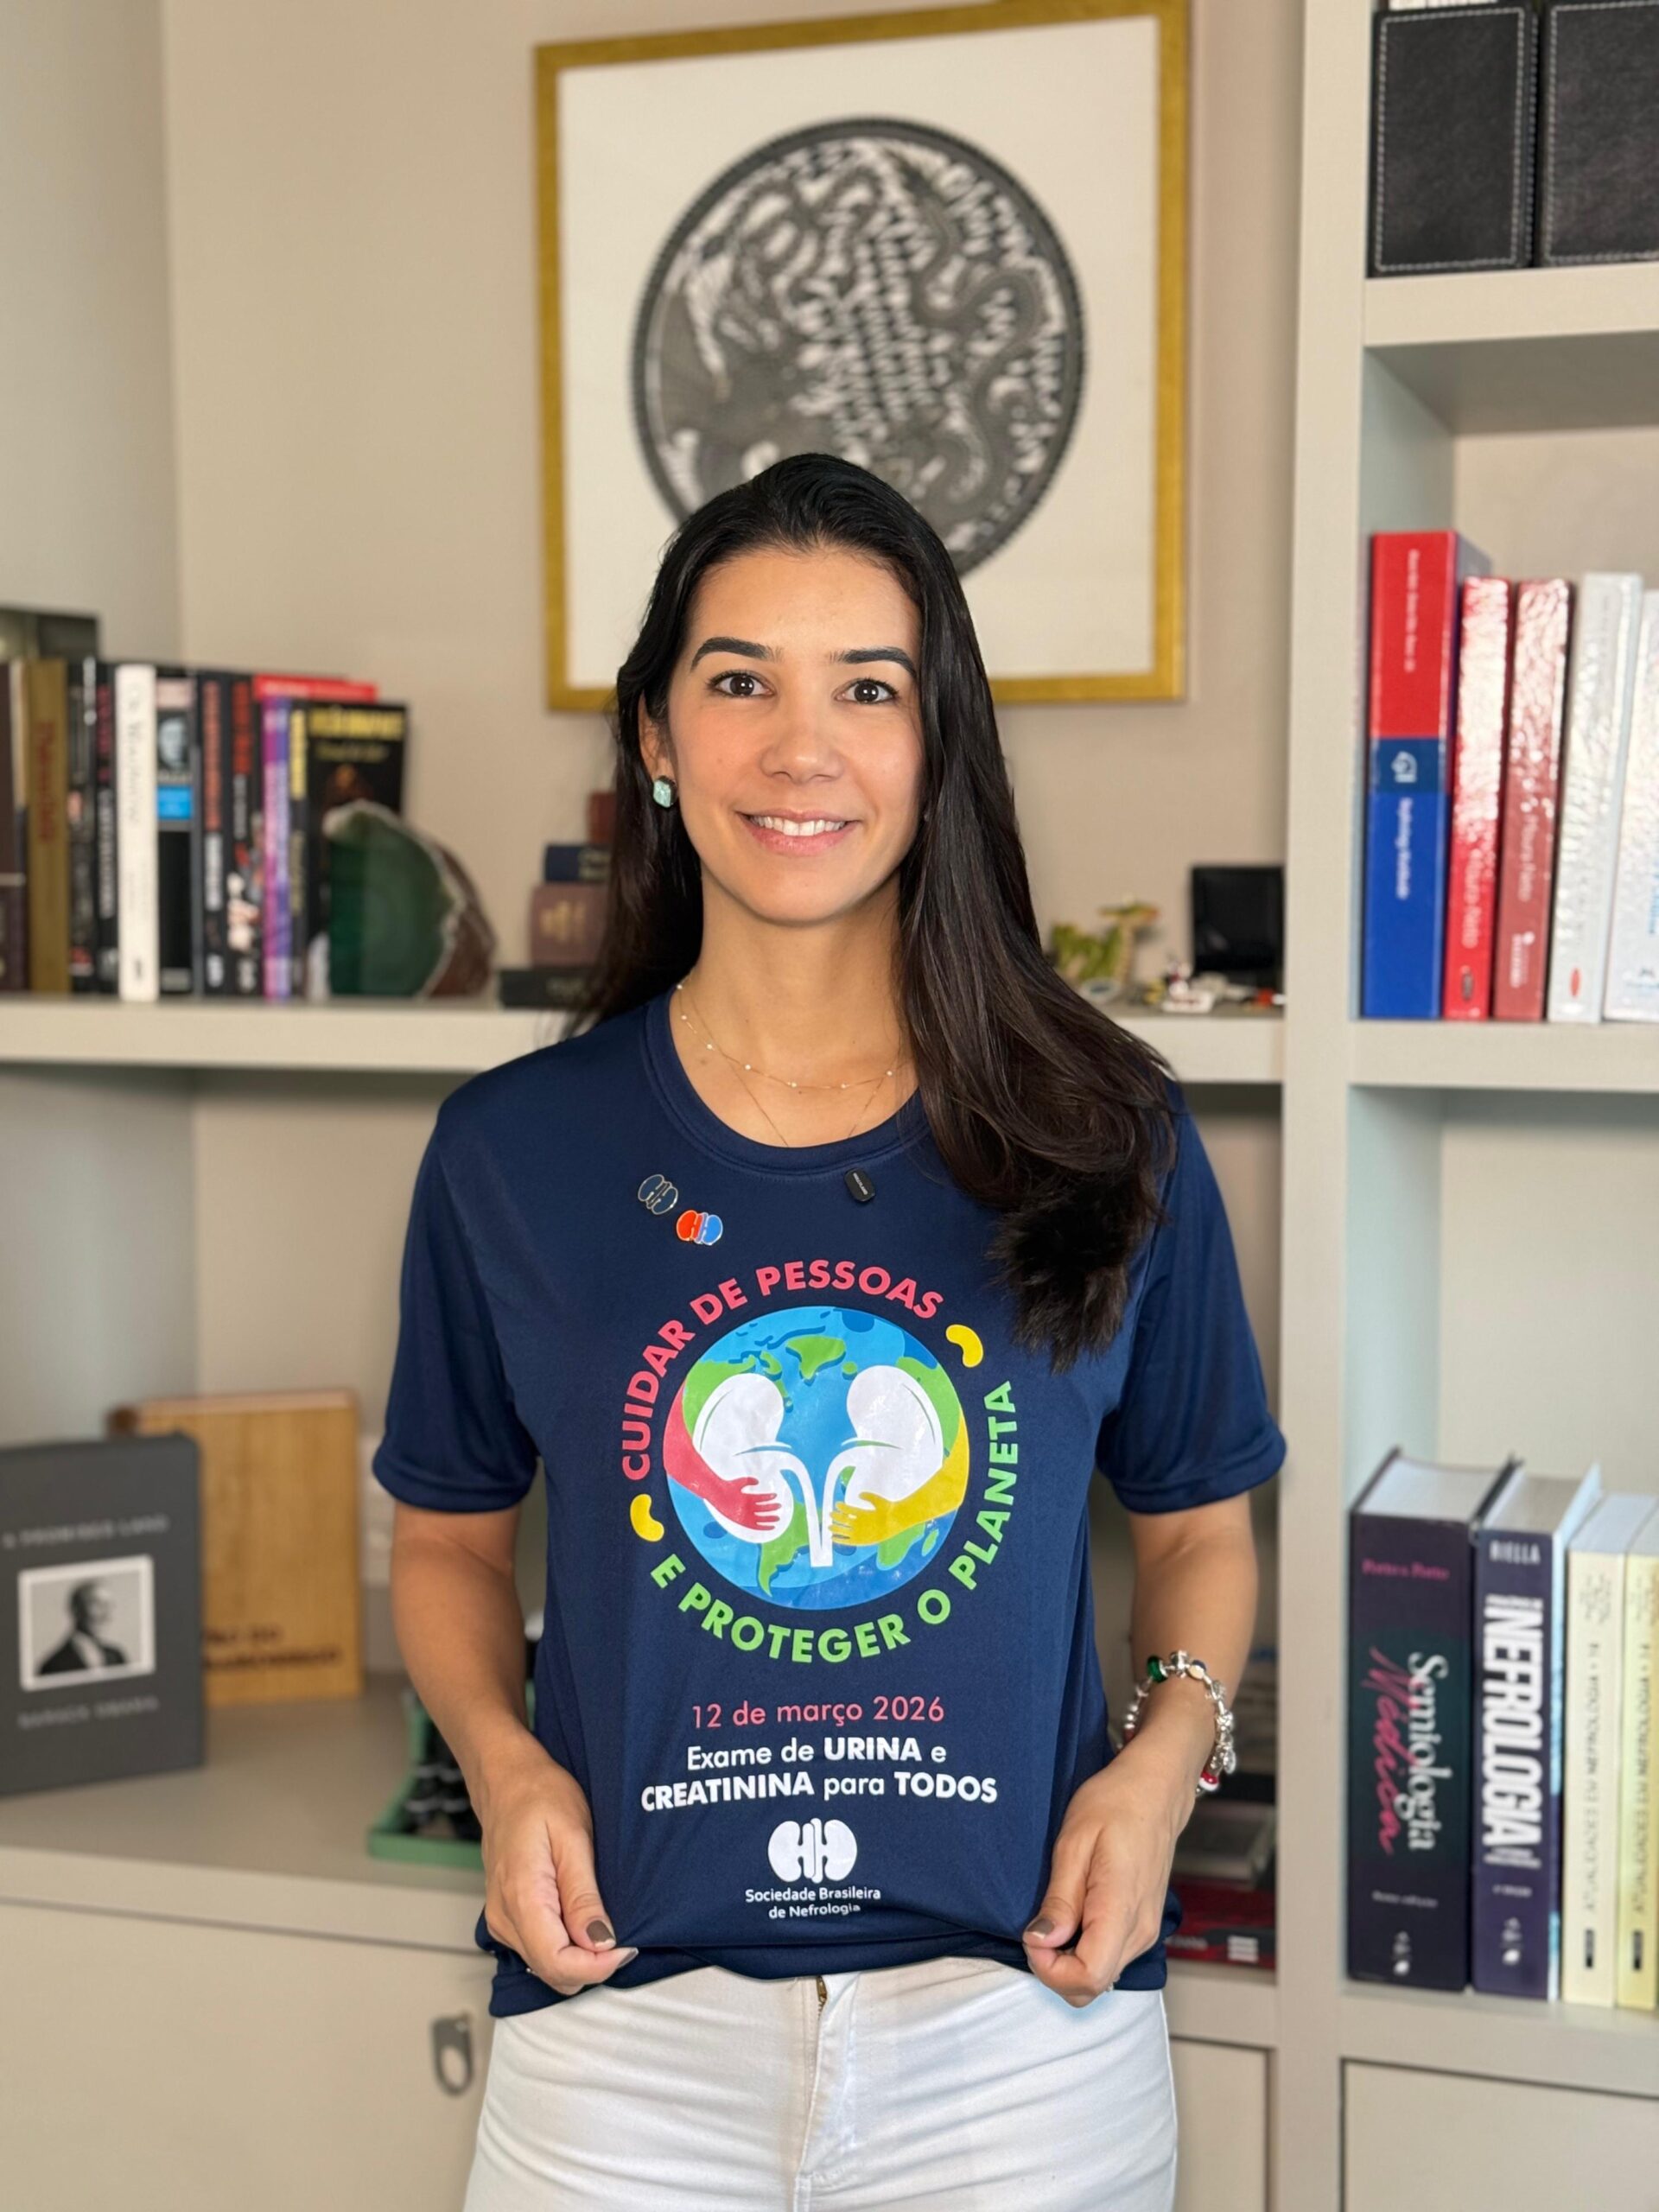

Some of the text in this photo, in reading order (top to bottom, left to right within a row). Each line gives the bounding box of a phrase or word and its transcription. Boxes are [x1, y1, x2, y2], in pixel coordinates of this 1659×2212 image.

[622, 1259, 944, 1480] CUIDAR DE PESSOAS
[651, 1381, 1018, 1663] E PROTEGER O PLANETA
[694, 1695, 944, 1728] 12 de março 2026
[1483, 1605, 1544, 1847] NEFROLOGIA
[687, 1737, 947, 1770] Exame de URINA e
[1394, 1651, 1452, 1851] Semiologia
[641, 1771, 998, 1812] CREATININA para TODOS
[745, 1885, 881, 1903] Sociedade Brasileira
[768, 1901, 861, 1919] de Nefrologia
